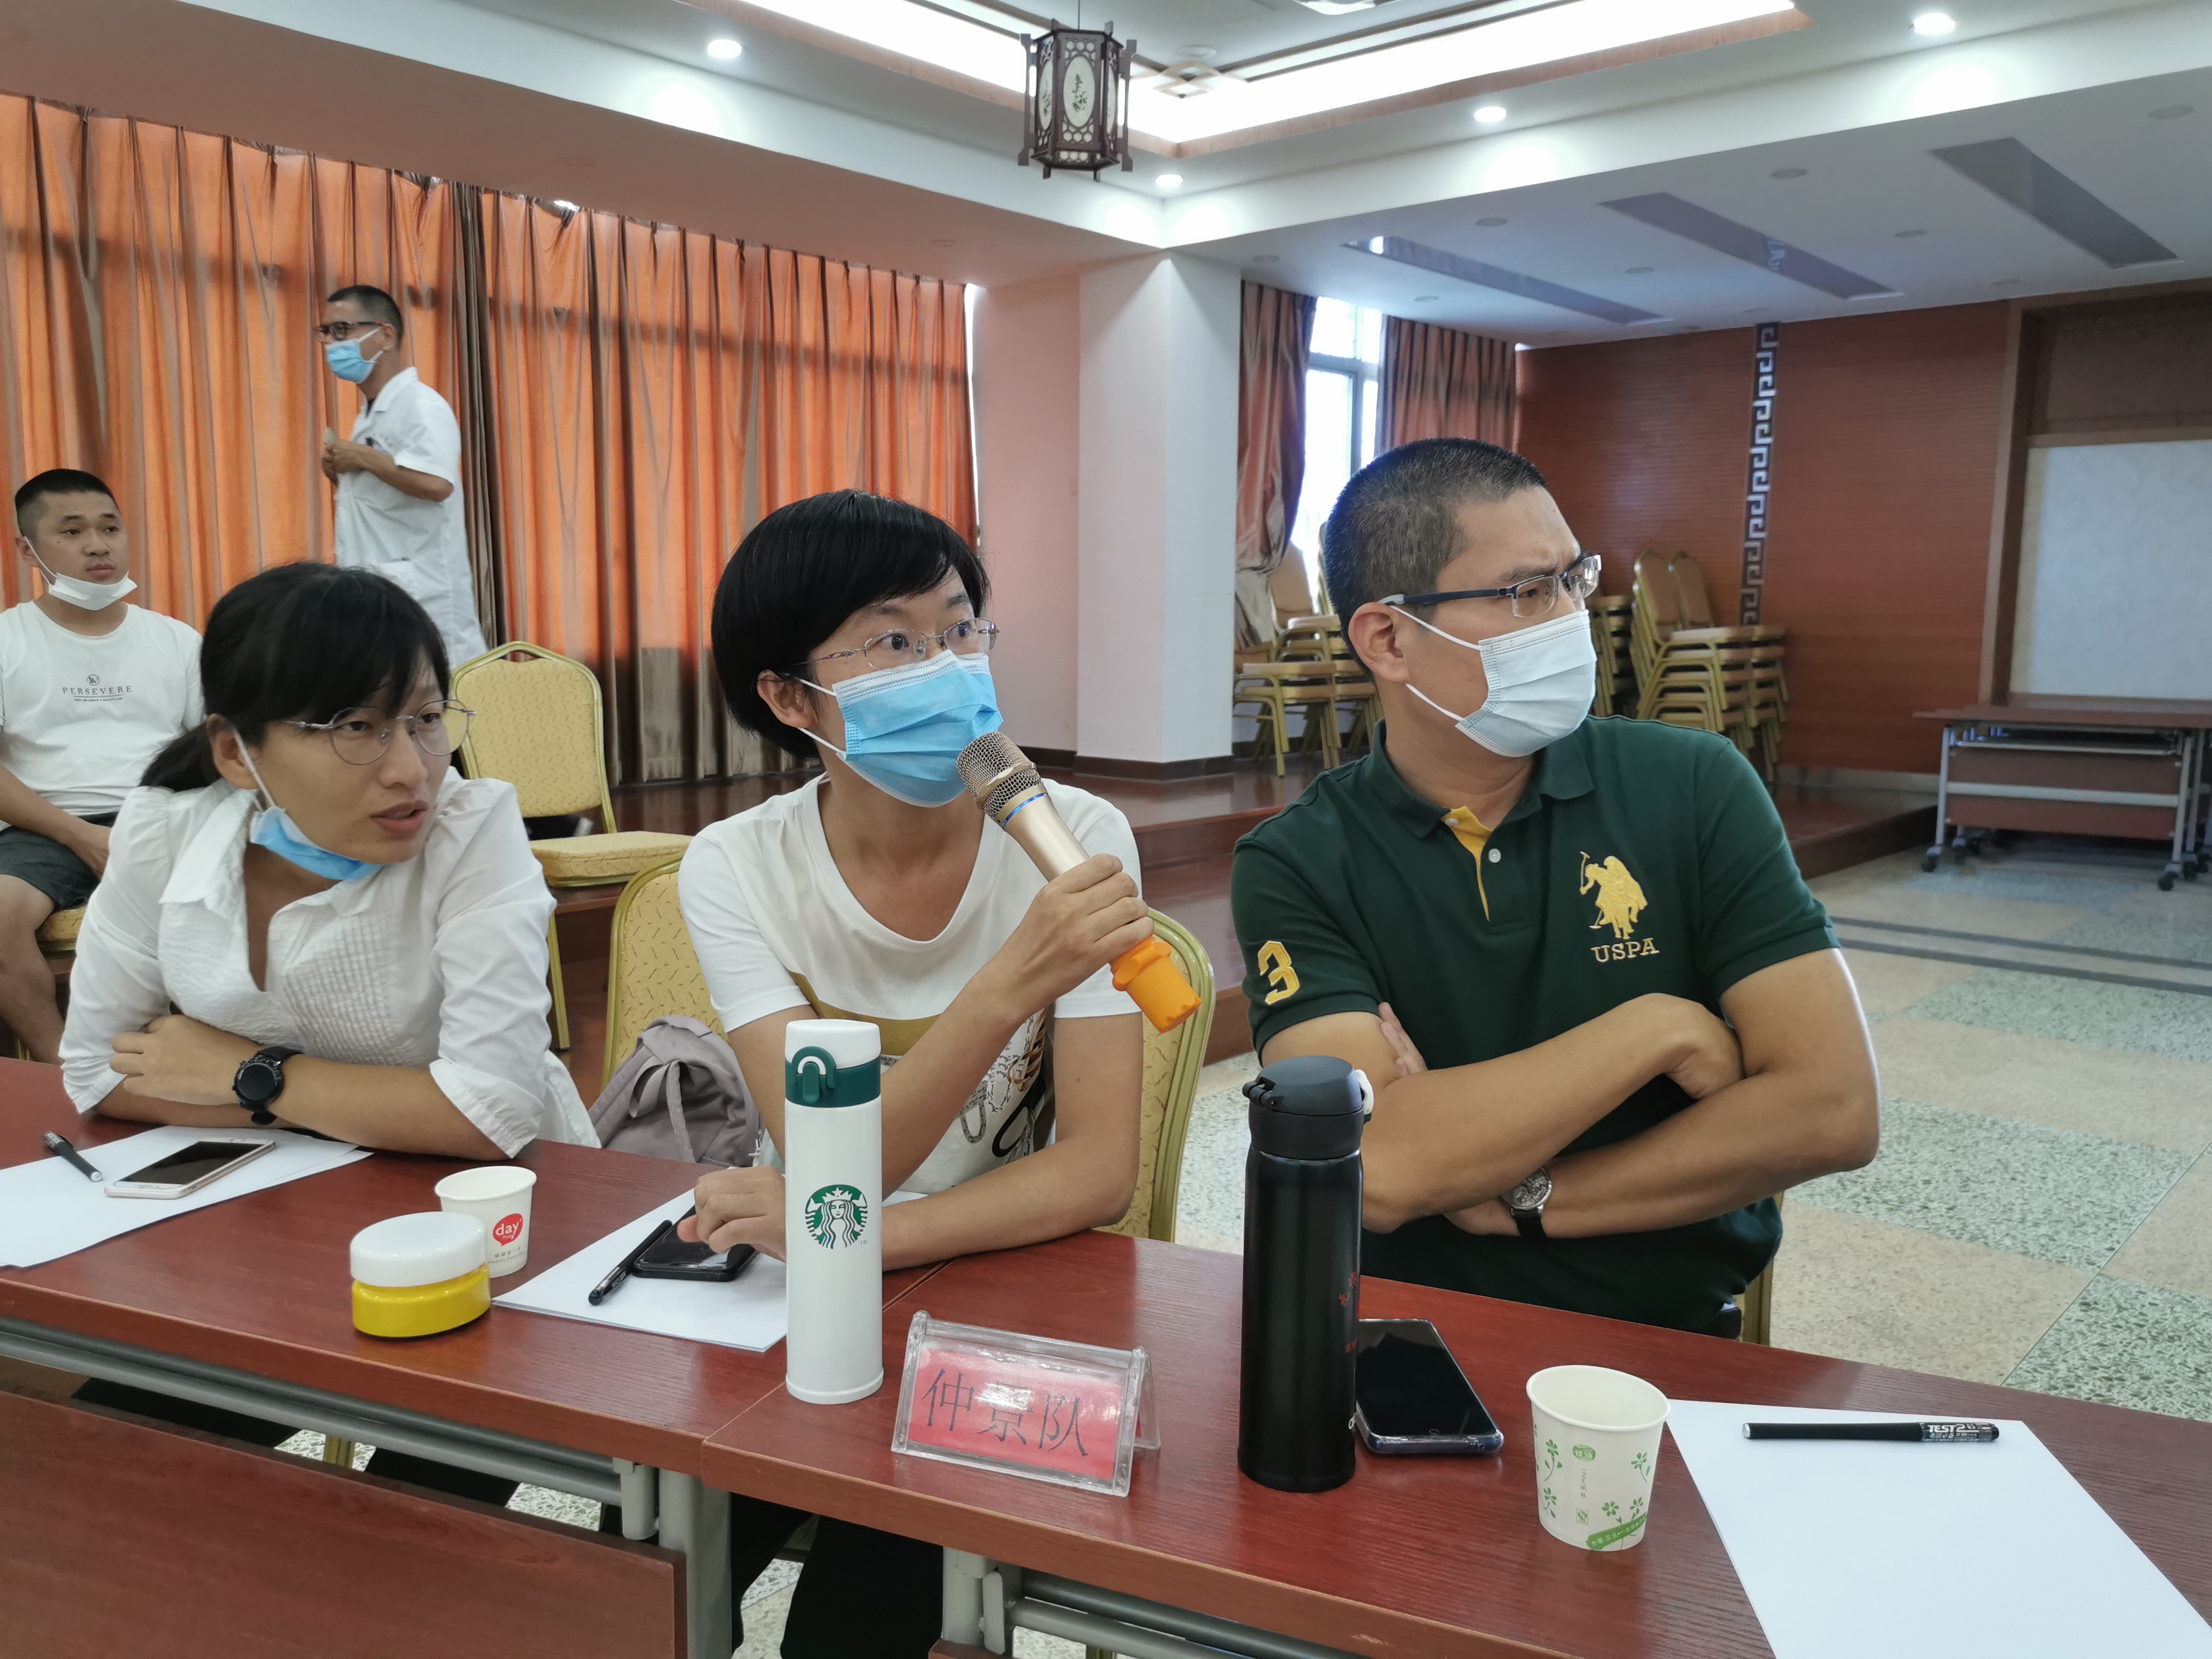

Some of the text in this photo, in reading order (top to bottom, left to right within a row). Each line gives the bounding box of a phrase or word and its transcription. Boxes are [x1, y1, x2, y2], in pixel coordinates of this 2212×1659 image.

[62, 685, 132, 695] PERSEVERE
[1590, 937, 1660, 963] USPA
[1257, 940, 1300, 1005] 3
[495, 1221, 520, 1239] day
